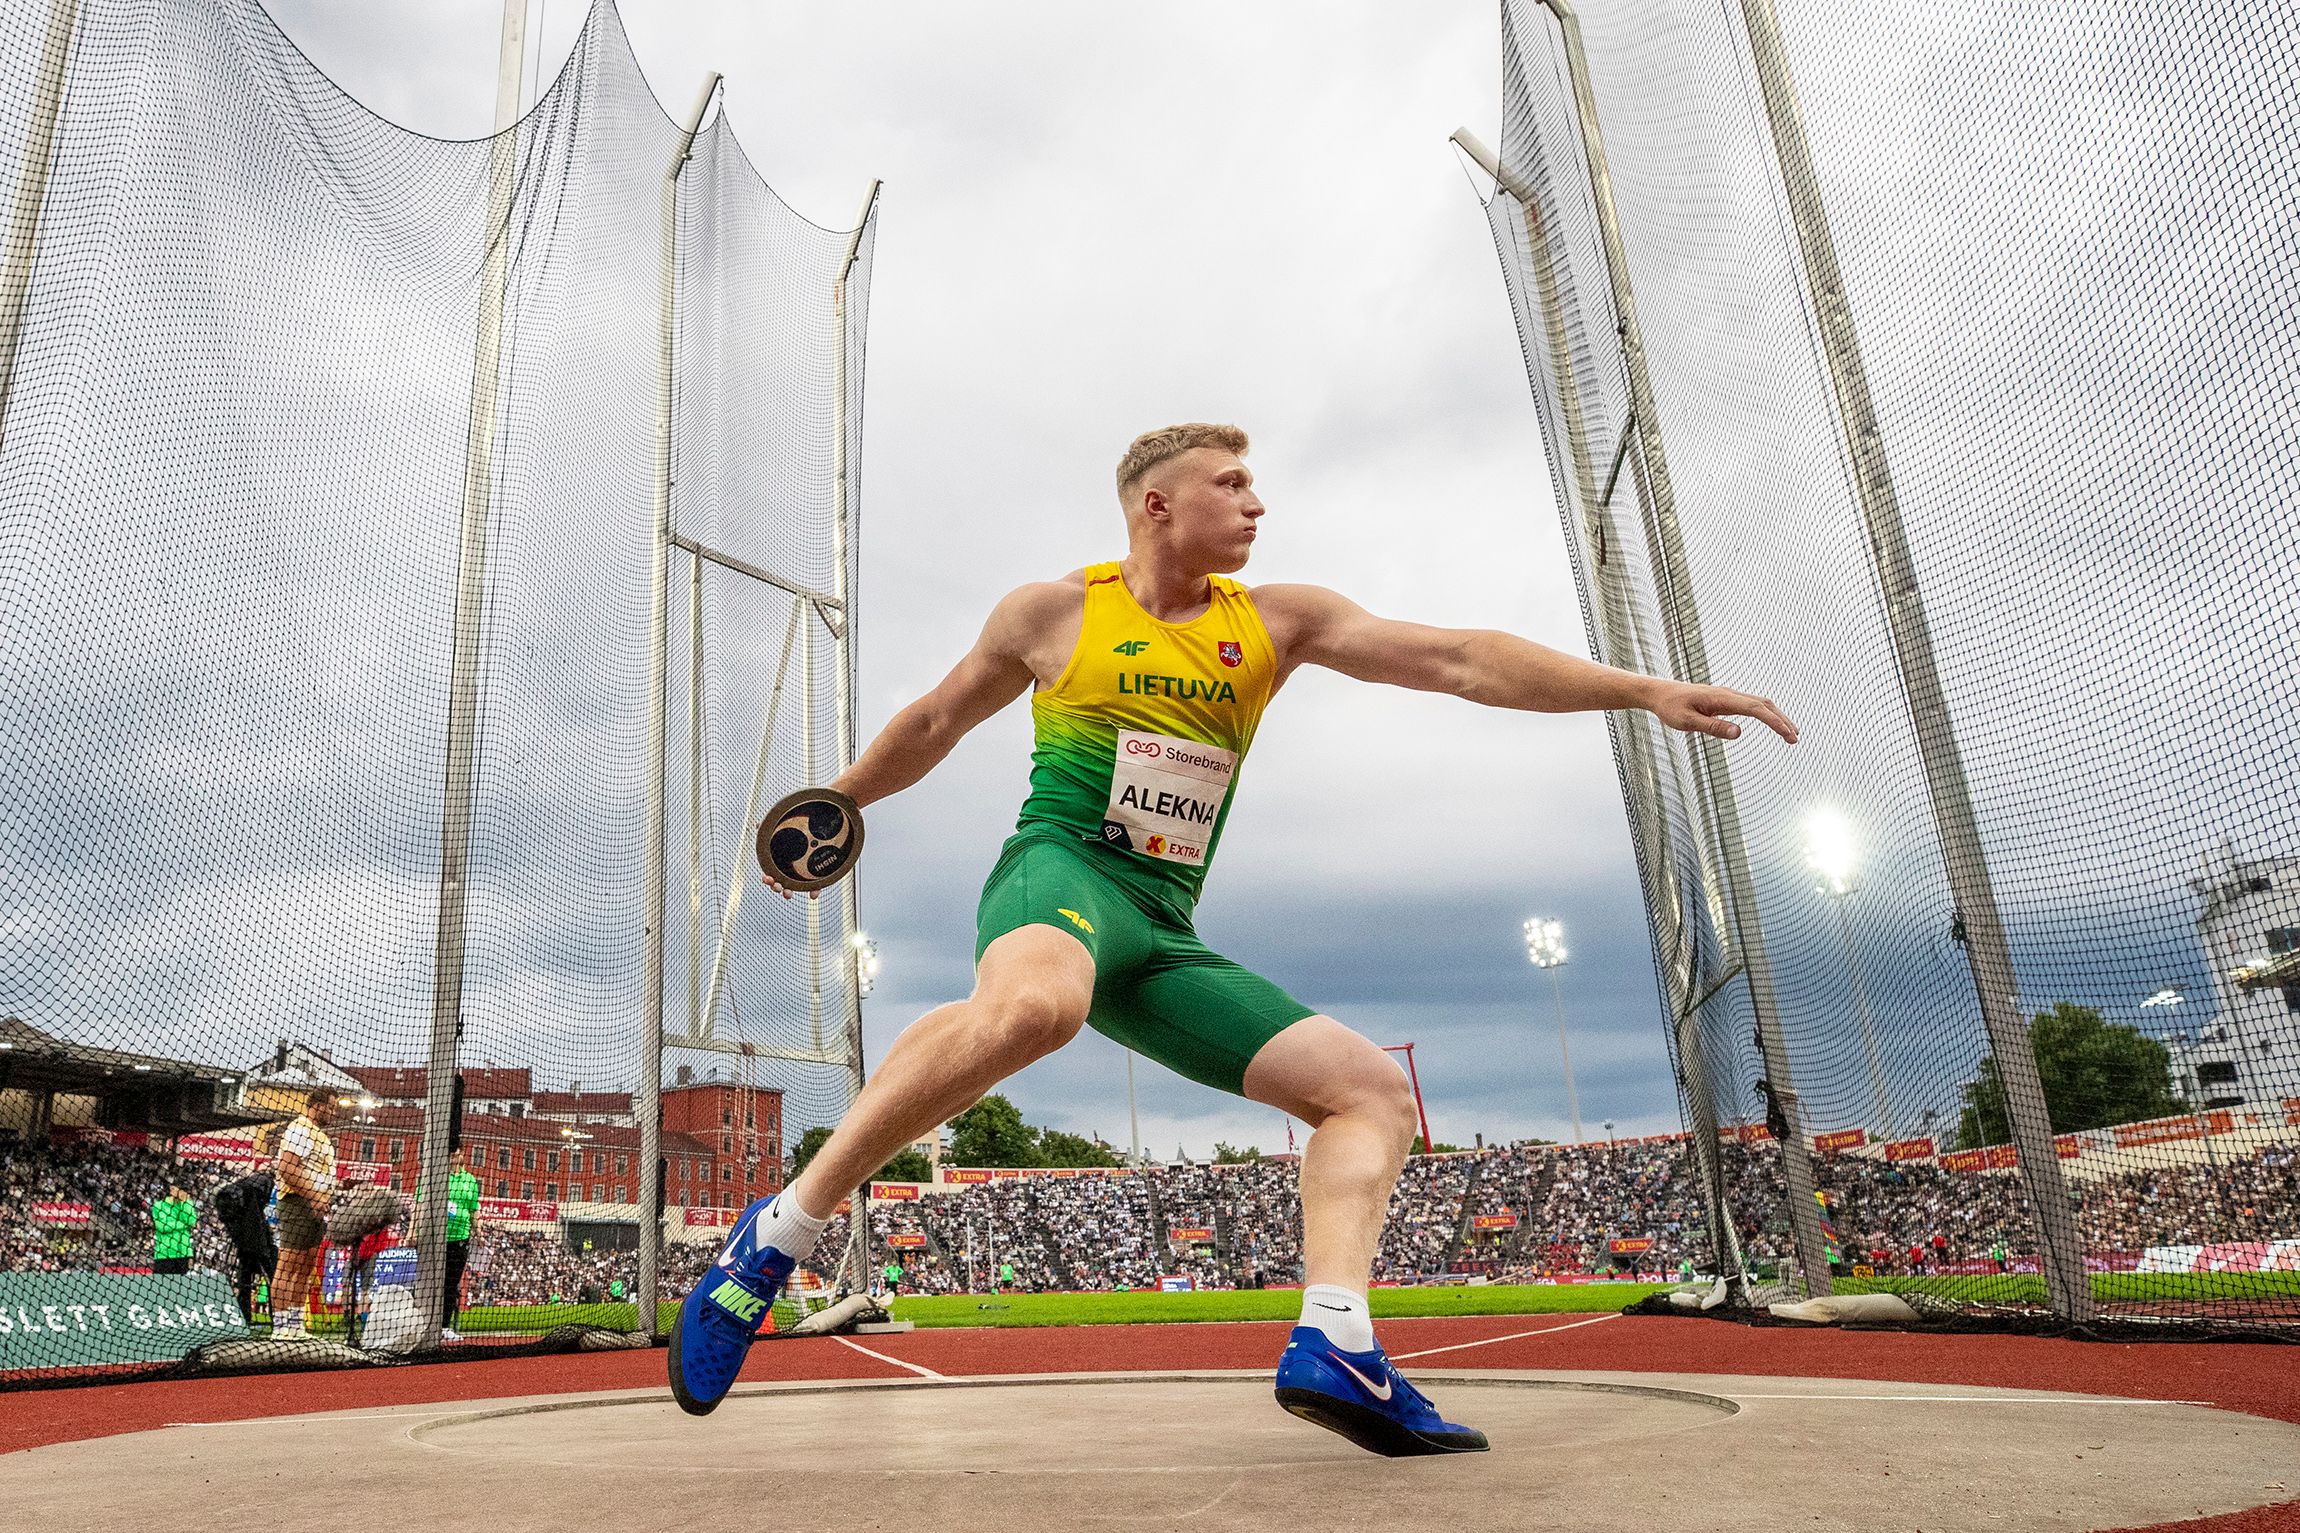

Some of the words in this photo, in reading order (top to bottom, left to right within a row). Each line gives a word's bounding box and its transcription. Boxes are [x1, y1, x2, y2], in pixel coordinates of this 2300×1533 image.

[1113, 640, 1150, 657] 4F
[1119, 673, 1236, 703] LIETUVA
[1165, 747, 1231, 774] Storebrand
[1119, 784, 1215, 826] ALEKNA
[1169, 843, 1200, 859] EXTRA
[708, 1279, 769, 1323] NIKE
[127, 1303, 244, 1331] GAMES
